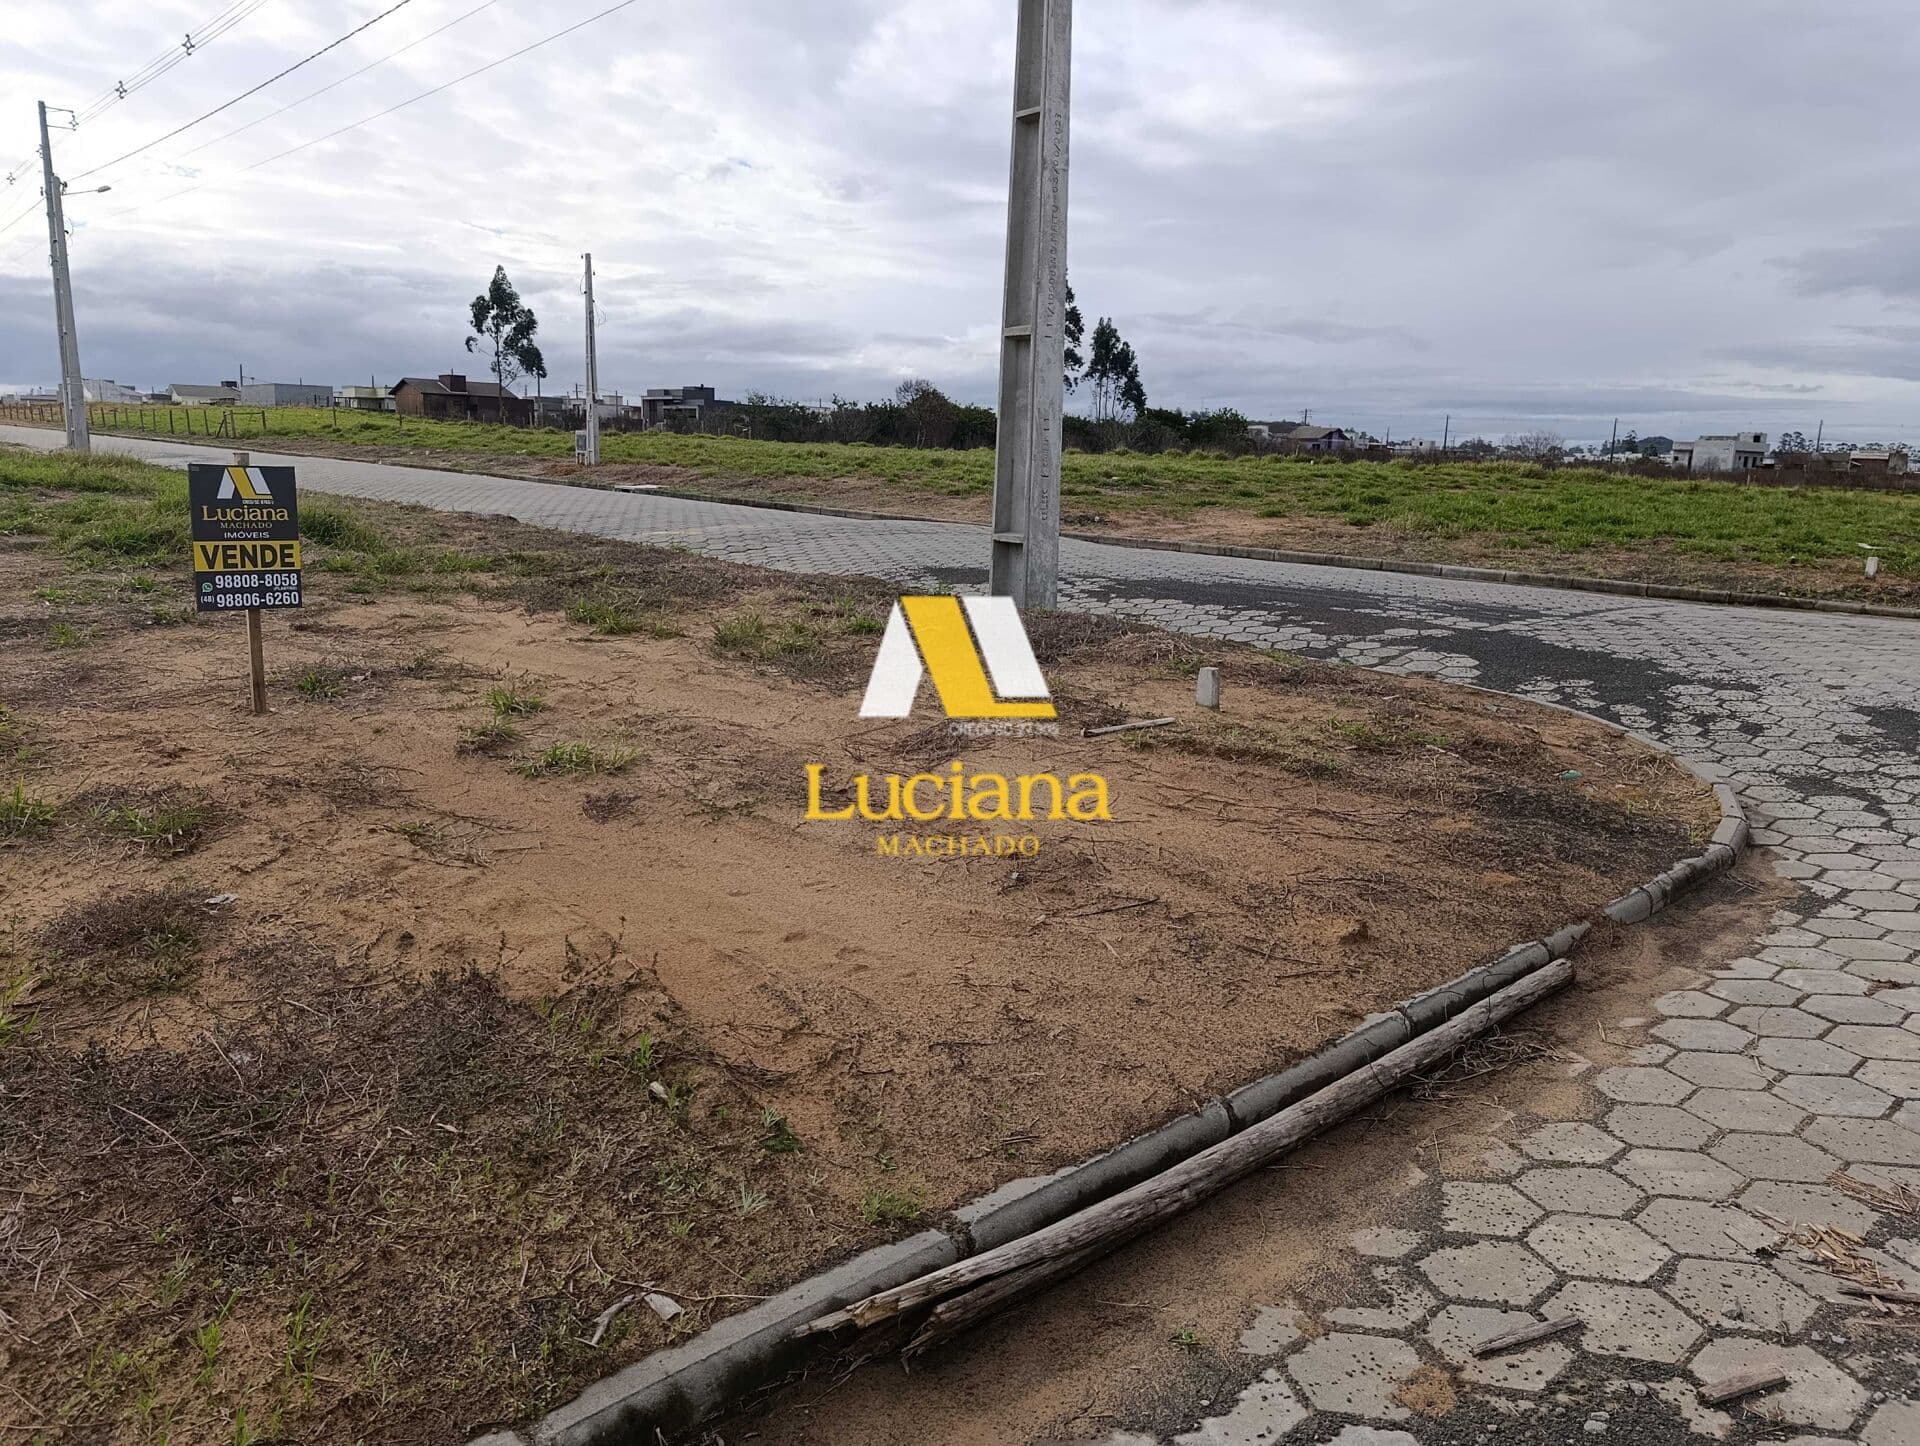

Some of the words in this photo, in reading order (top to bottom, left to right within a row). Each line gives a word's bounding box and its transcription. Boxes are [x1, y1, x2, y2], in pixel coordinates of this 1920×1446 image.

[202, 505, 289, 521] Luciana
[224, 531, 270, 539] IMÓVEIS
[200, 543, 296, 570] VENDE
[215, 573, 298, 588] 98808-8058
[216, 592, 299, 607] 98806-6260
